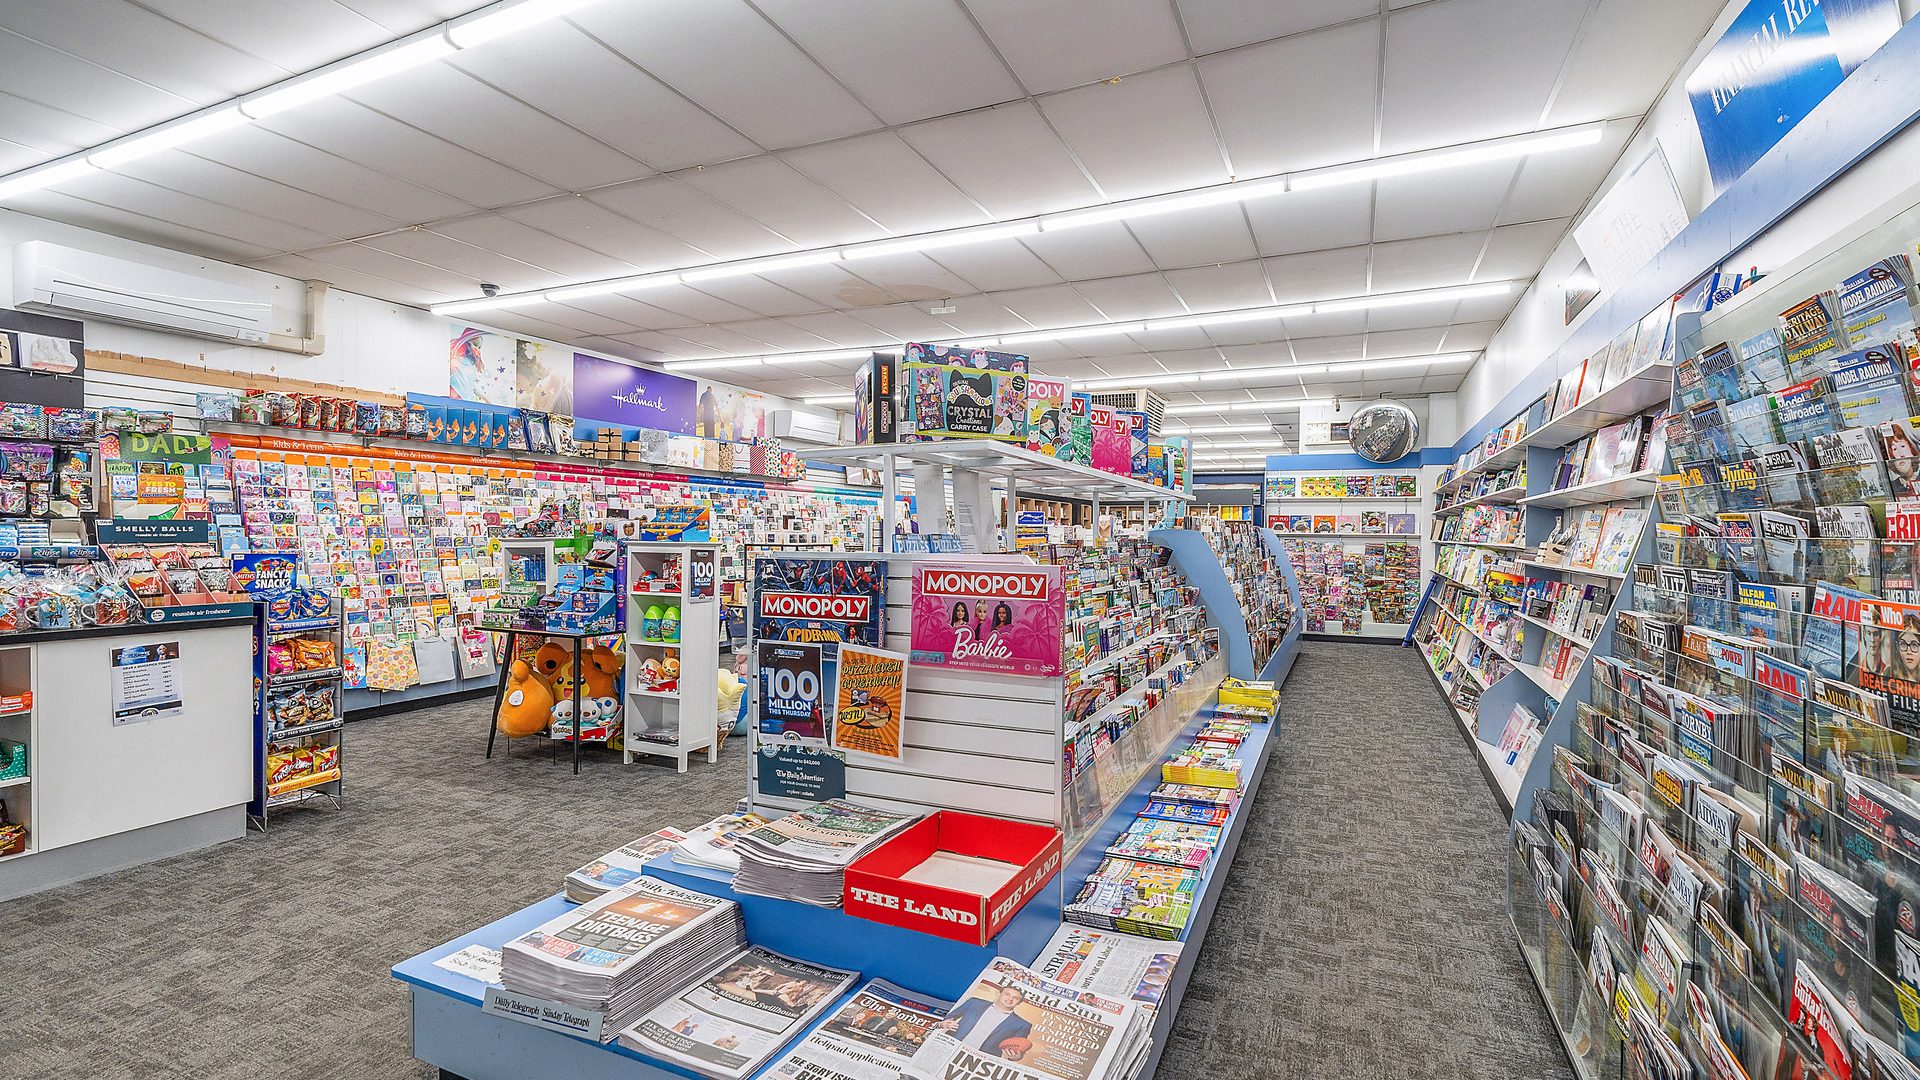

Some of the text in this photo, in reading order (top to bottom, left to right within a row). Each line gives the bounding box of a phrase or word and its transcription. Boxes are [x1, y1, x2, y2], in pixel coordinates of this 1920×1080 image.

[1841, 276, 1897, 311] MODEL RAILWAY
[1788, 338, 1836, 363] Blue Peter is back!
[1834, 361, 1894, 386] MODEL RAILWAY
[1868, 378, 1897, 389] MAGAZINE
[611, 388, 667, 411] Hallmark
[947, 385, 993, 406] SQUISHMALLOWS
[947, 406, 992, 418] CRYSTAL
[956, 416, 983, 425] Creations
[1777, 402, 1825, 423] Railroader
[131, 433, 190, 454] DAD
[273, 440, 291, 448] Kids
[301, 442, 324, 451] Teens
[359, 471, 367, 480] 5
[1662, 494, 1678, 502] WORLD
[1666, 503, 1676, 511] WAR
[470, 524, 481, 536] 21
[1886, 514, 1920, 542] CRI
[33, 548, 60, 556] eclipse
[69, 547, 96, 556] eclipse
[896, 540, 929, 552] PUZZLES
[934, 540, 962, 552] PUZZLES
[1659, 543, 1674, 552] WORLD
[257, 571, 283, 579] FANCY
[693, 562, 713, 578] 100
[255, 579, 291, 589] SNACK?
[927, 573, 1044, 595] MONOPOLY
[765, 596, 866, 617] MONOPOLY
[1881, 606, 1902, 625] Who
[787, 628, 843, 642] SPIDER-MAN
[952, 628, 1012, 660] Barbie
[843, 661, 902, 677] PIZZA OVEN
[842, 676, 901, 690] GIVEAWAY!
[1758, 664, 1802, 699] RAIL
[1865, 674, 1887, 690] REAL
[768, 699, 812, 711] MILLION
[782, 709, 811, 718] THURSDAY
[840, 709, 864, 721] WIN!
[800, 772, 824, 783] Advertiser
[782, 818, 804, 829] SHOW
[818, 828, 870, 840] STRENGTH
[1855, 833, 1875, 849] PETE
[618, 848, 640, 861] Night
[634, 878, 723, 905] Daily Telegraph
[992, 885, 1022, 926] THE
[1023, 851, 1060, 894] LAND
[851, 887, 977, 926] THE LAND
[578, 920, 654, 944] DIRTBAGS
[596, 911, 670, 936] TEENAGE
[449, 958, 468, 967] SOLD
[767, 953, 790, 968] Sydney
[791, 960, 821, 976] Morning
[821, 969, 848, 981] Herald
[704, 981, 799, 1019] Sex, sleaze and Swillhouse
[494, 996, 590, 1028] Daily Telegraph Sunday Telegraph
[860, 996, 885, 1013] The
[888, 1006, 931, 1027] Border
[1065, 1003, 1103, 1022] Sun
[1042, 1011, 1108, 1037] PASSIONATE
[1042, 1020, 1100, 1042] FEARLESS
[658, 1026, 669, 1036] OFF
[676, 1033, 696, 1047] STOCK
[1034, 1025, 1101, 1051] RESPECTED
[1041, 1034, 1087, 1054] ADORED
[810, 1035, 902, 1073] Helipad application
[789, 1056, 833, 1077] THE STORY
